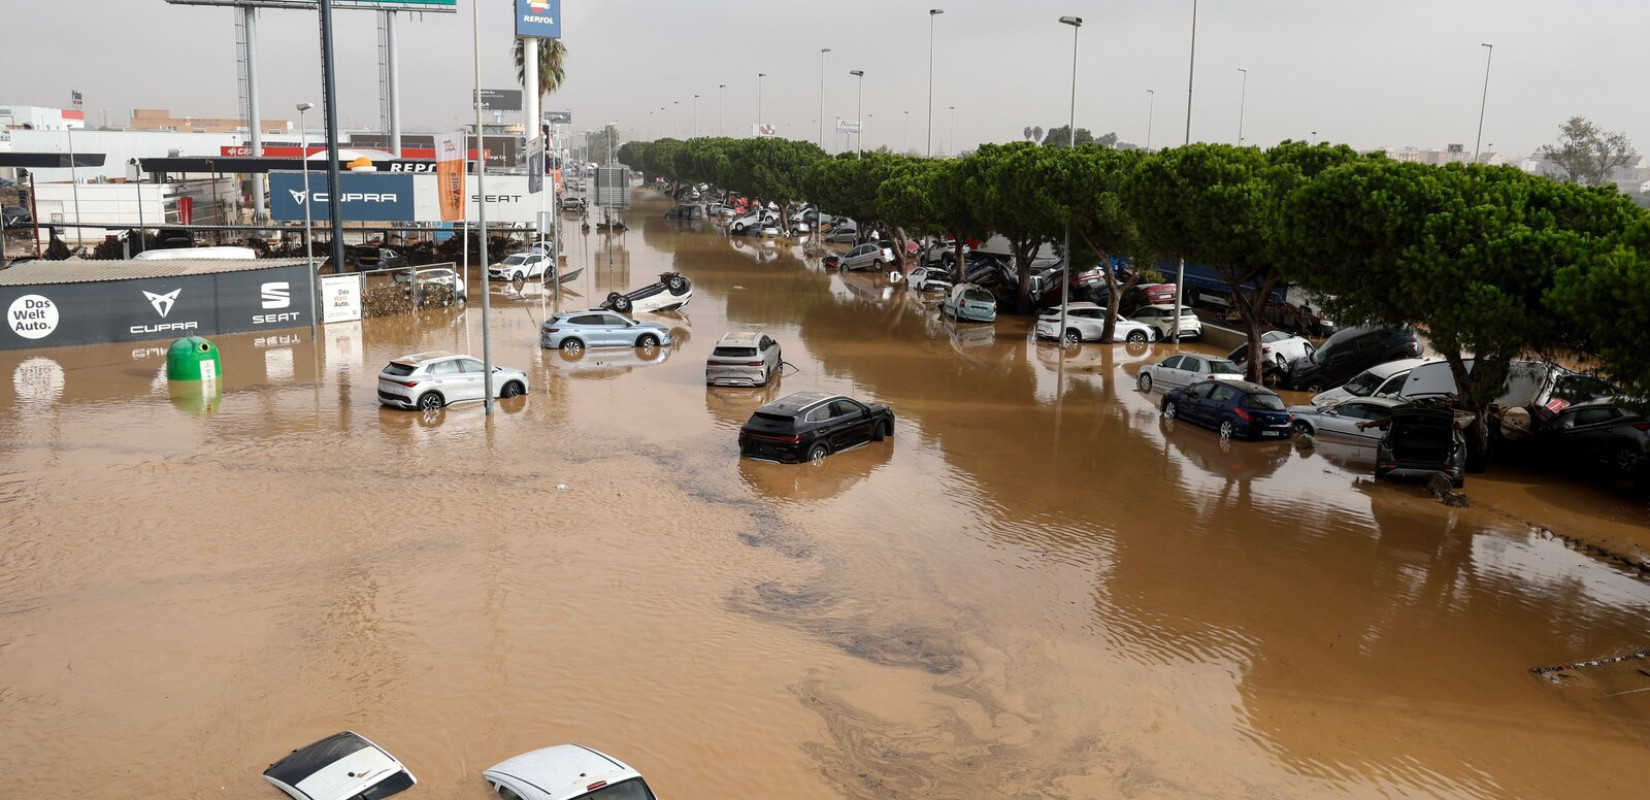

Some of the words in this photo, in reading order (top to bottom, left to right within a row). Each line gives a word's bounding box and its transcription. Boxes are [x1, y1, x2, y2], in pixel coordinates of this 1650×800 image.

[523, 15, 554, 24] REPSOL
[390, 163, 437, 172] REPS
[25, 299, 51, 309] Das
[13, 309, 46, 320] Welt
[252, 312, 300, 324] SEAT
[15, 321, 52, 331] Auto.
[129, 321, 198, 334] CUPRA
